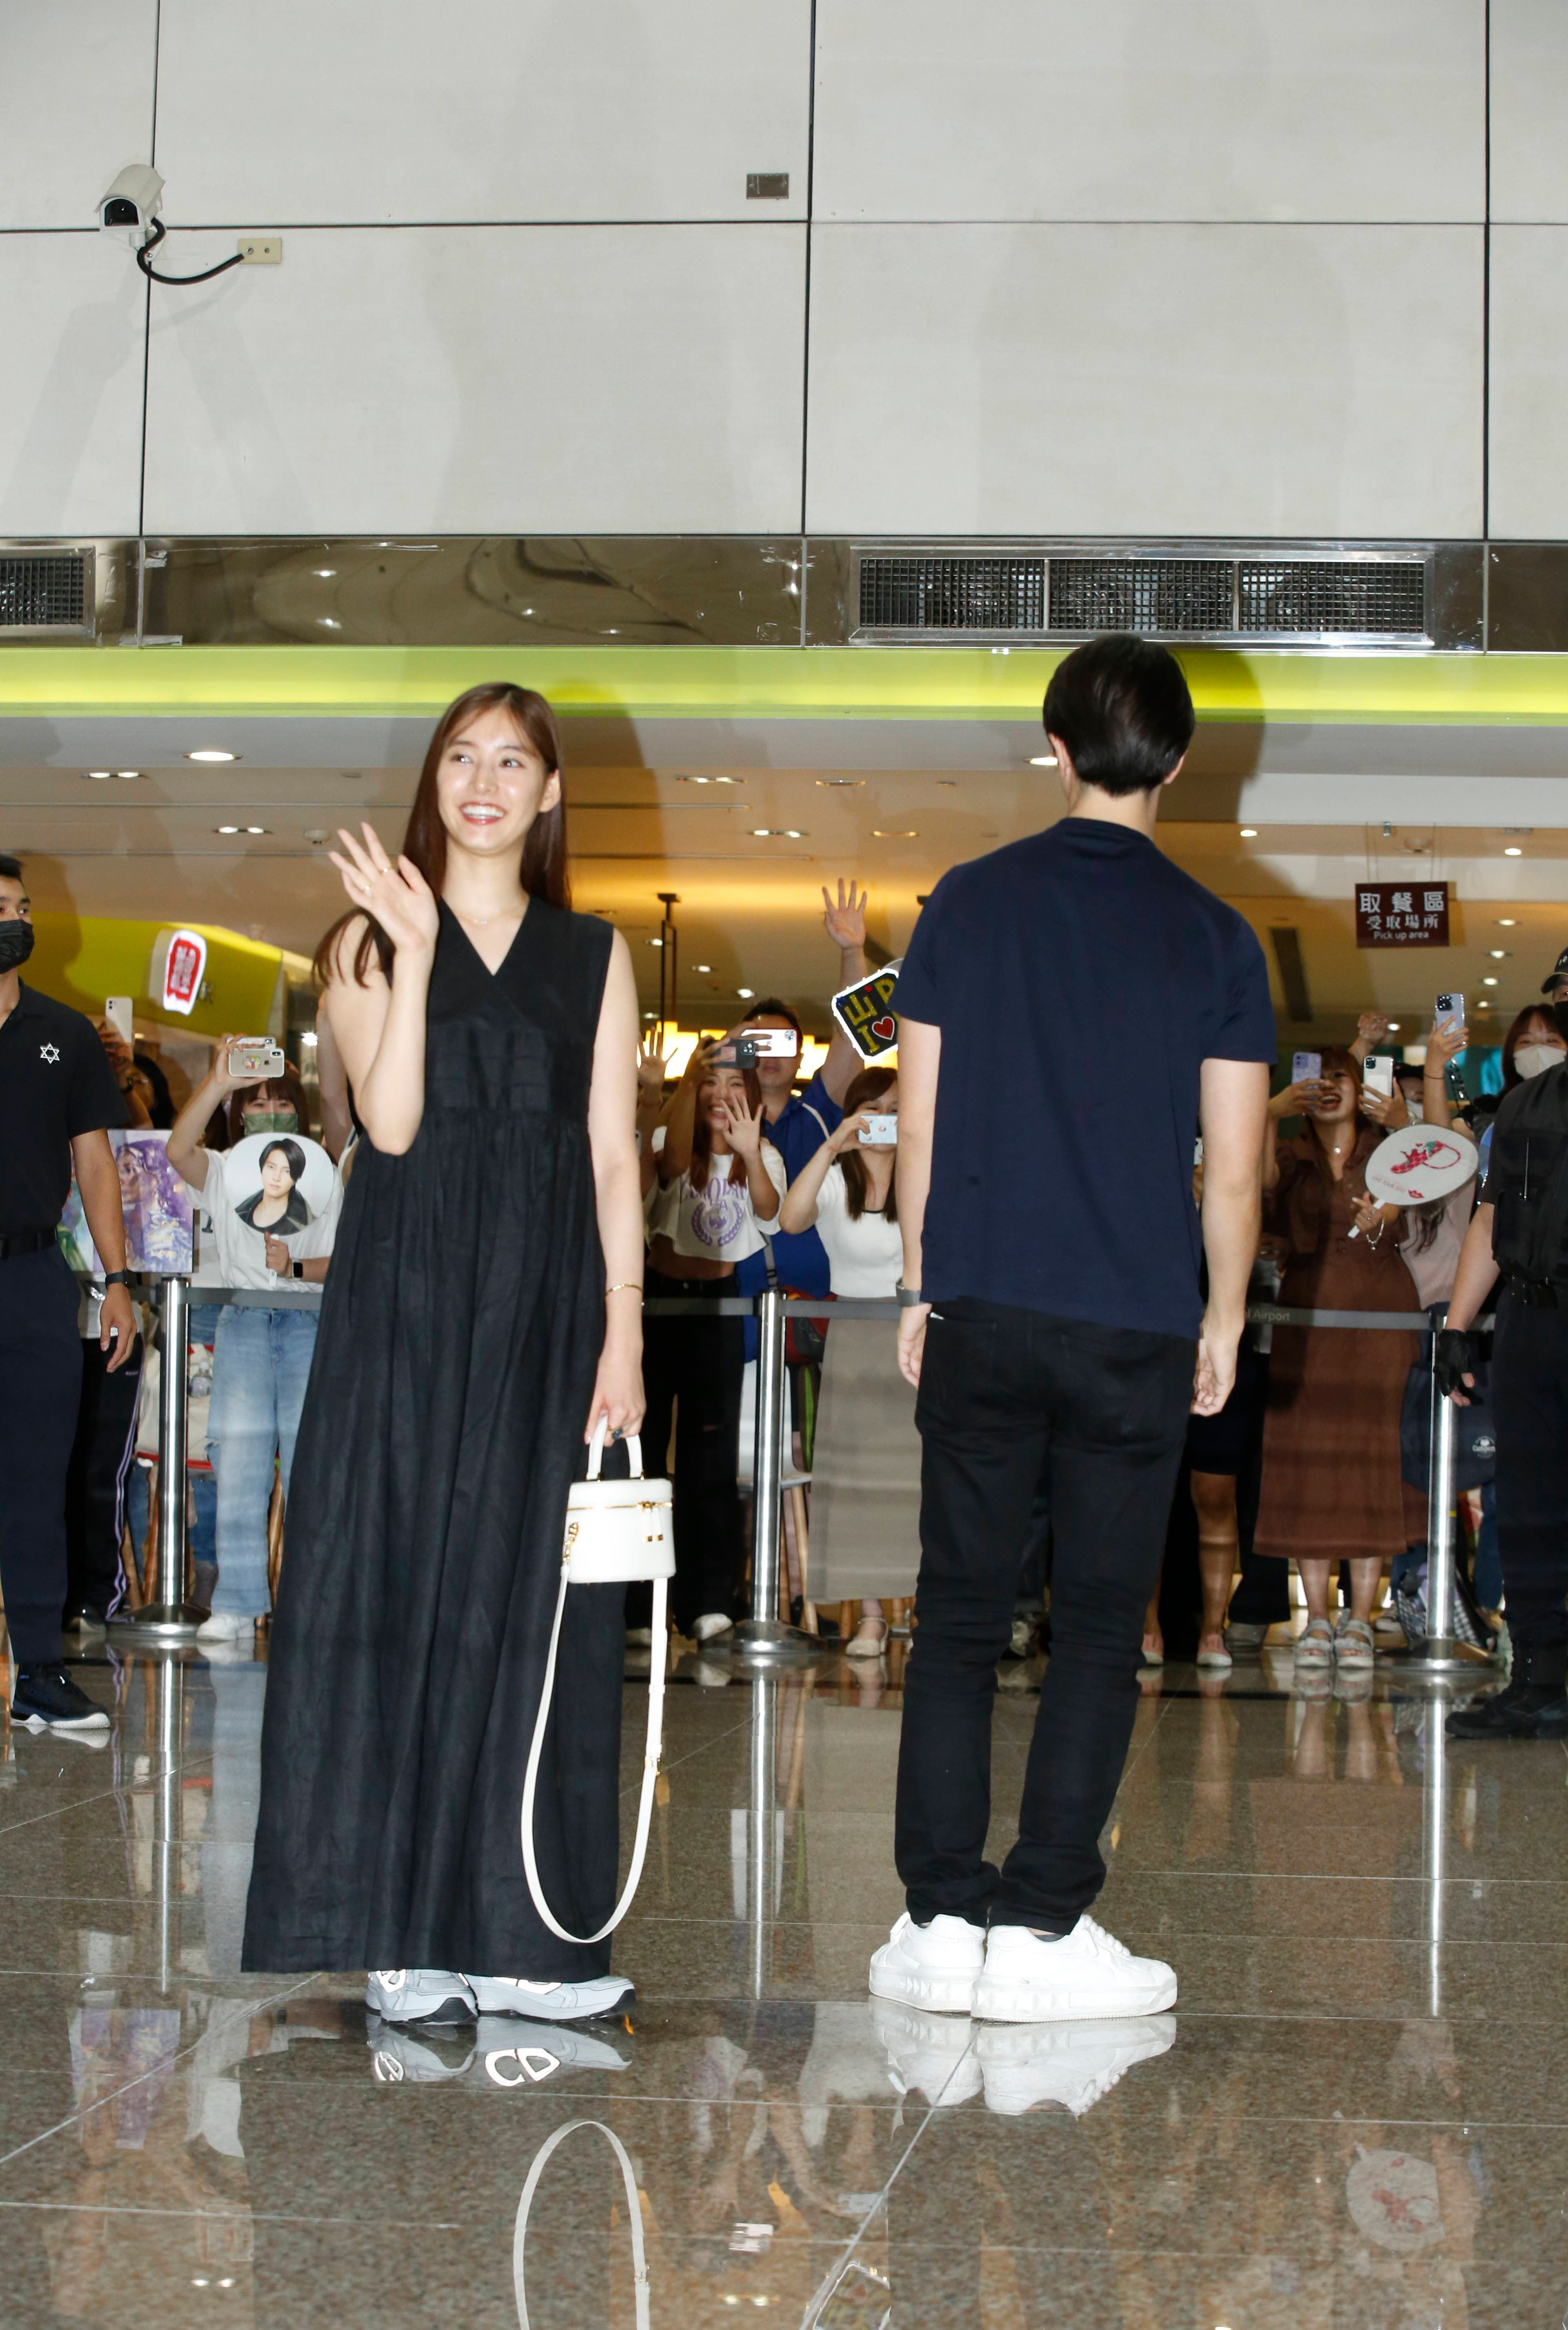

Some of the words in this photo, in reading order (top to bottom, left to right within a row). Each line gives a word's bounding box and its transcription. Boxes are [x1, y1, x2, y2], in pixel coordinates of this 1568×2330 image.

[1359, 891, 1444, 913] 取餐區
[1367, 914, 1438, 930] 受取場所
[1374, 931, 1392, 939] Pick
[1253, 1309, 1290, 1322] Airport
